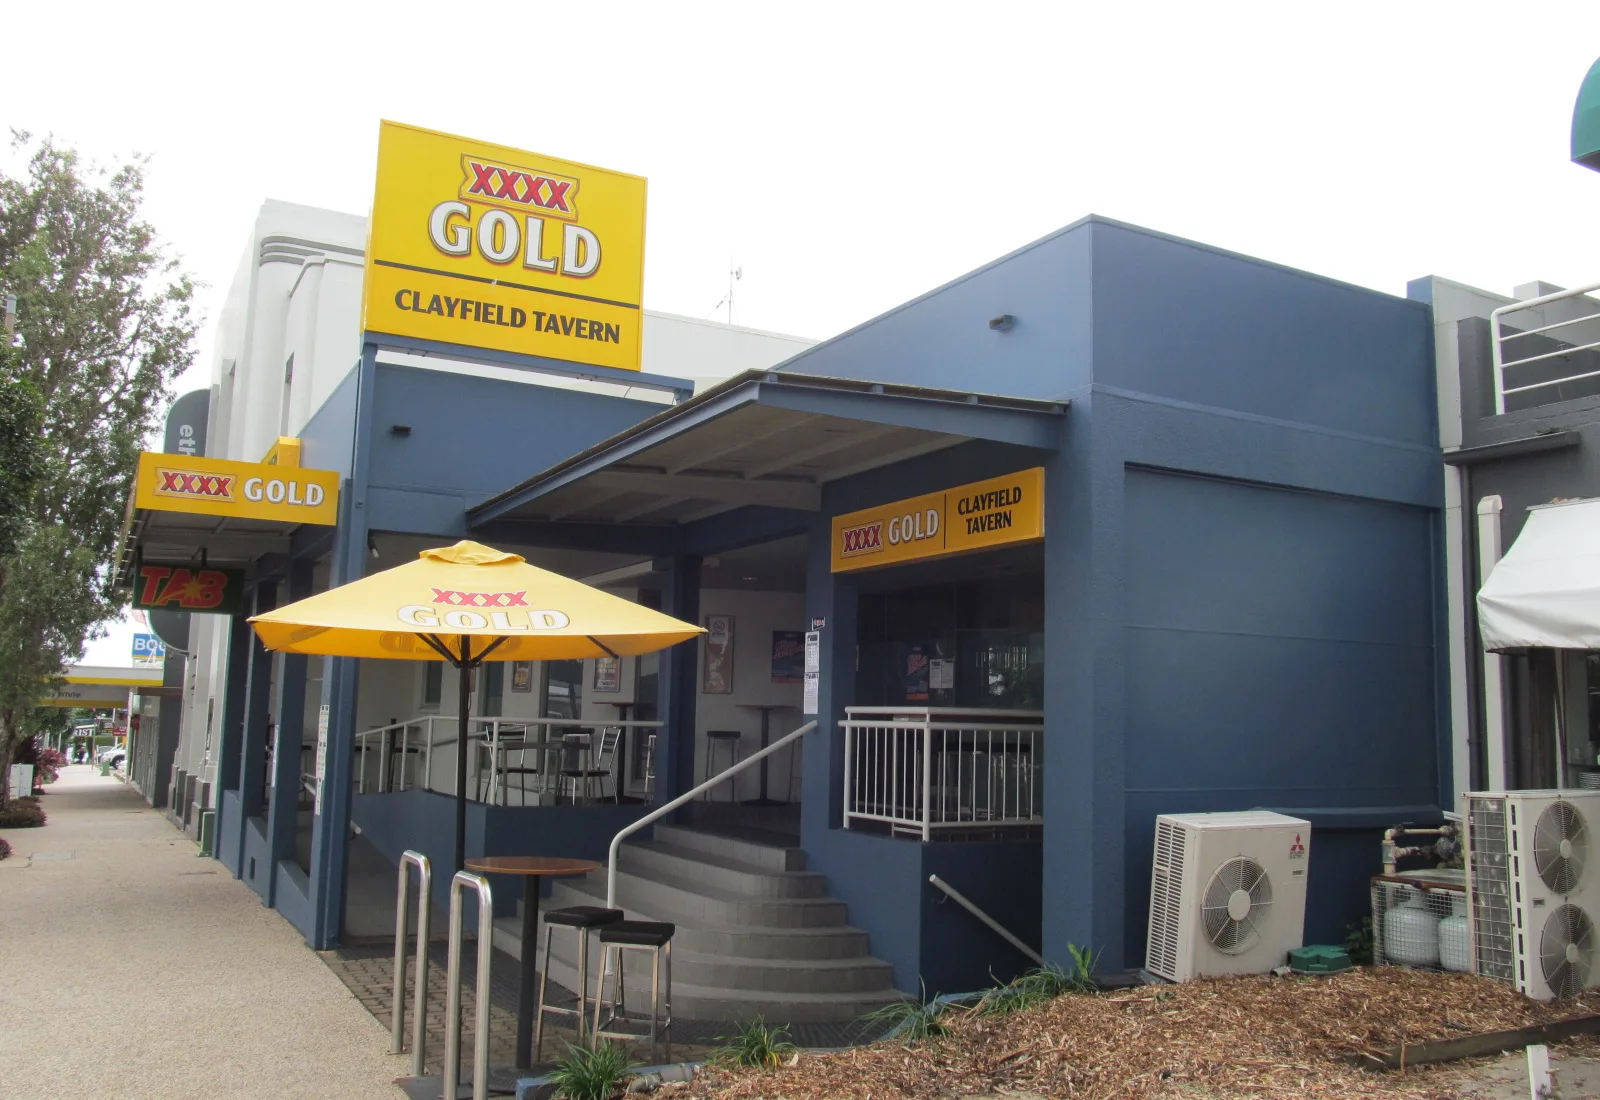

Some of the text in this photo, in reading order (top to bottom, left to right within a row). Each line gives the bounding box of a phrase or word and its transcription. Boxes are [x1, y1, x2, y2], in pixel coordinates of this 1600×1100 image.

[468, 161, 572, 213] XXXX
[428, 200, 602, 278] GOLD
[394, 288, 621, 345] CLAYFIELD TAVERN
[158, 471, 325, 507] XXXX GOLD
[957, 486, 1022, 516] CLAYFIELD
[843, 508, 940, 553] XXXX GOLD
[966, 510, 1013, 536] TAVERN
[140, 565, 228, 609] TAB
[431, 588, 530, 607] XXXX
[397, 604, 571, 631] GOLD
